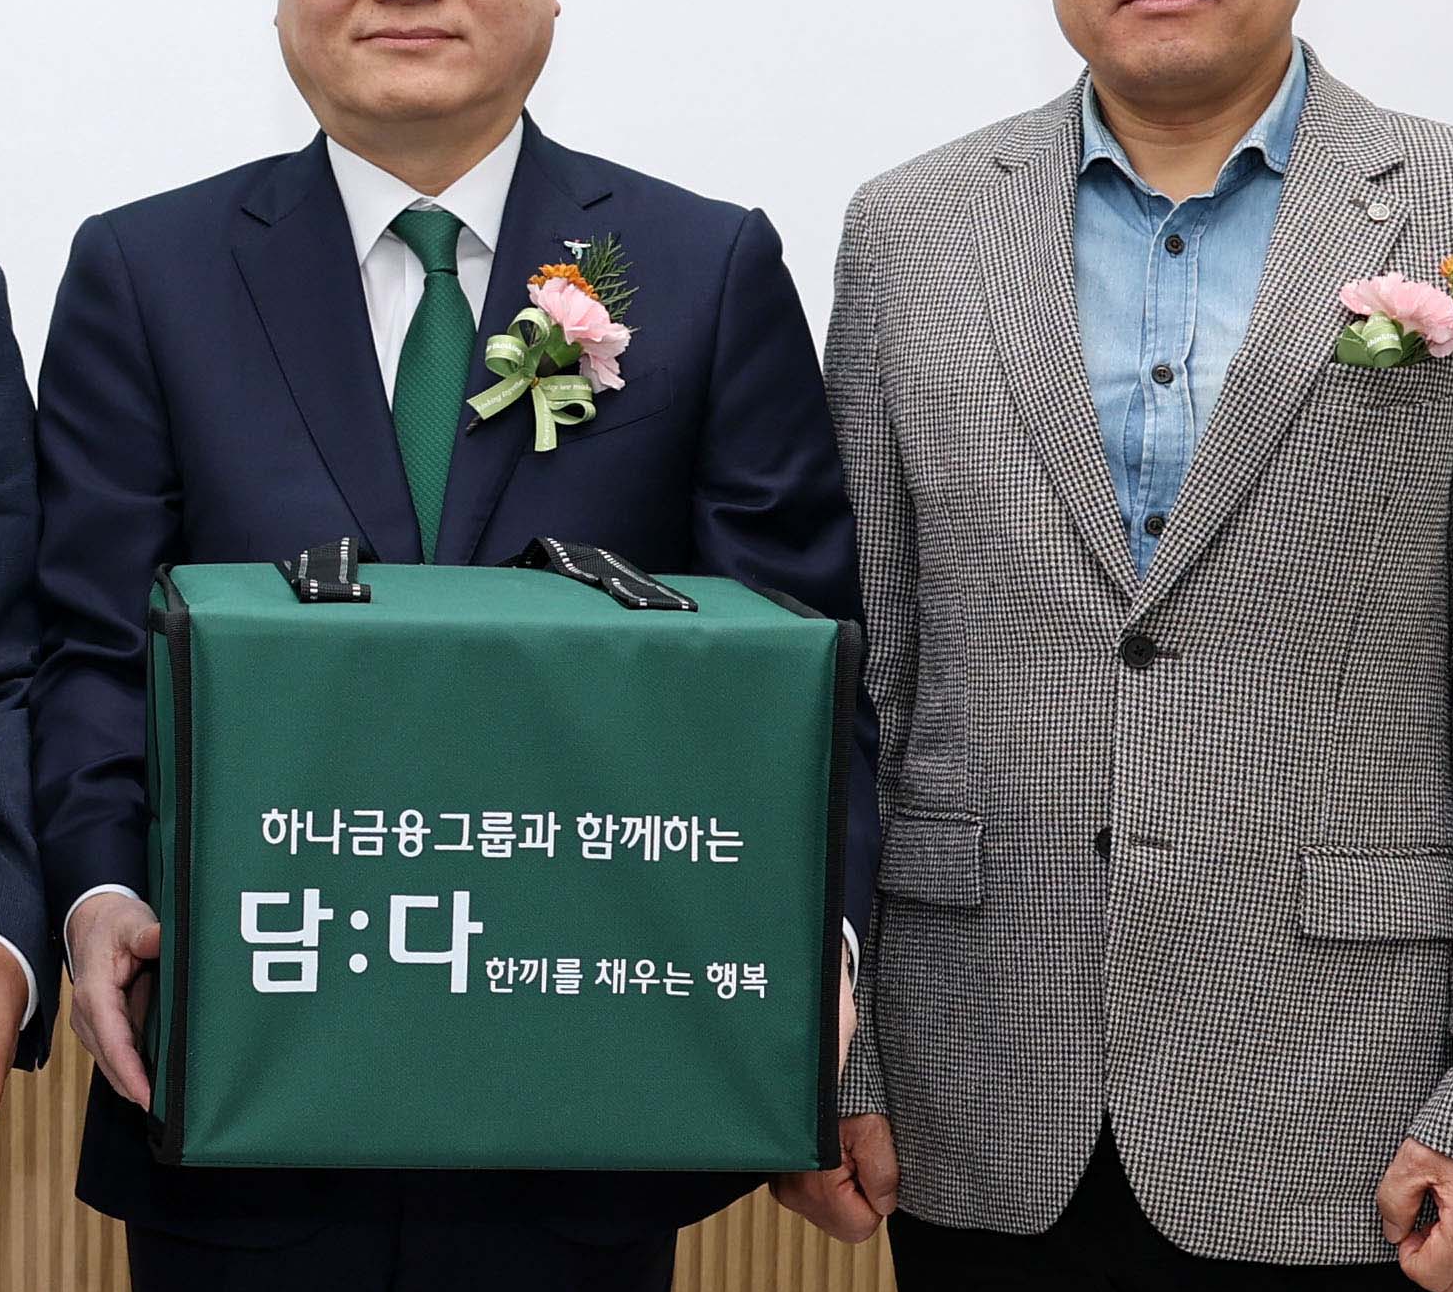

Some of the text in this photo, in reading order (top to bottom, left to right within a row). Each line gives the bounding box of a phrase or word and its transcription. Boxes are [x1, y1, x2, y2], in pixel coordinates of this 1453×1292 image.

[262, 808, 743, 862] 하나금융그룹과 함께하는
[486, 957, 583, 994] 한끼를
[595, 959, 693, 996] 채우는
[707, 962, 768, 999] 행복
